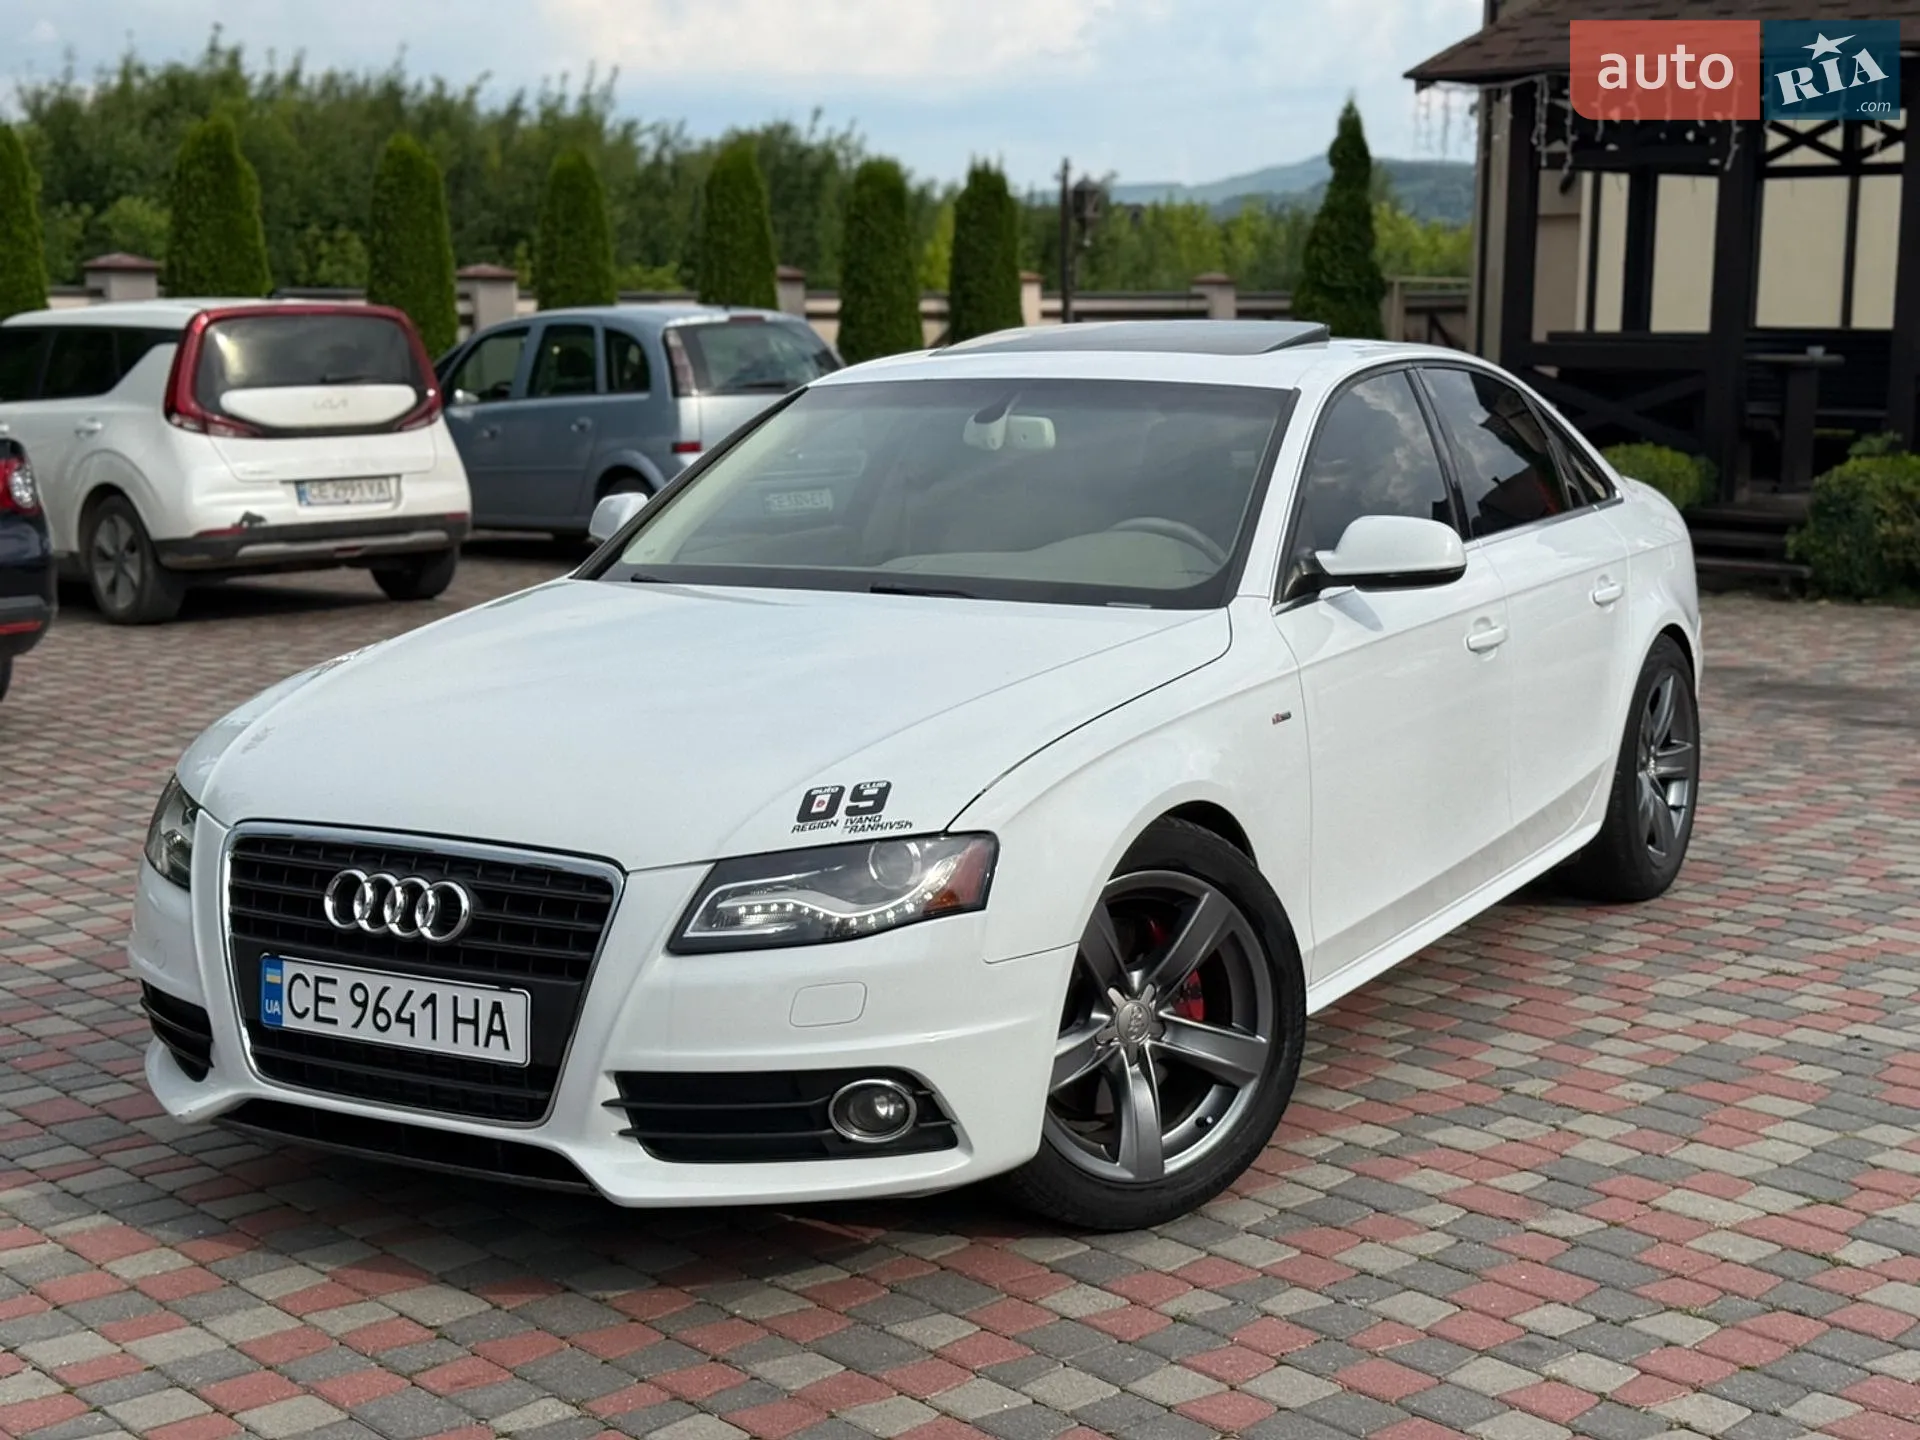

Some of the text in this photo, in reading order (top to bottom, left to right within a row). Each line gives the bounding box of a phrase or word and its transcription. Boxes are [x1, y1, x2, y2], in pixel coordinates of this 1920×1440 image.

[791, 815, 882, 834] REGION IVANO
[265, 999, 281, 1016] UA
[287, 972, 511, 1051] CE 9641 HA
